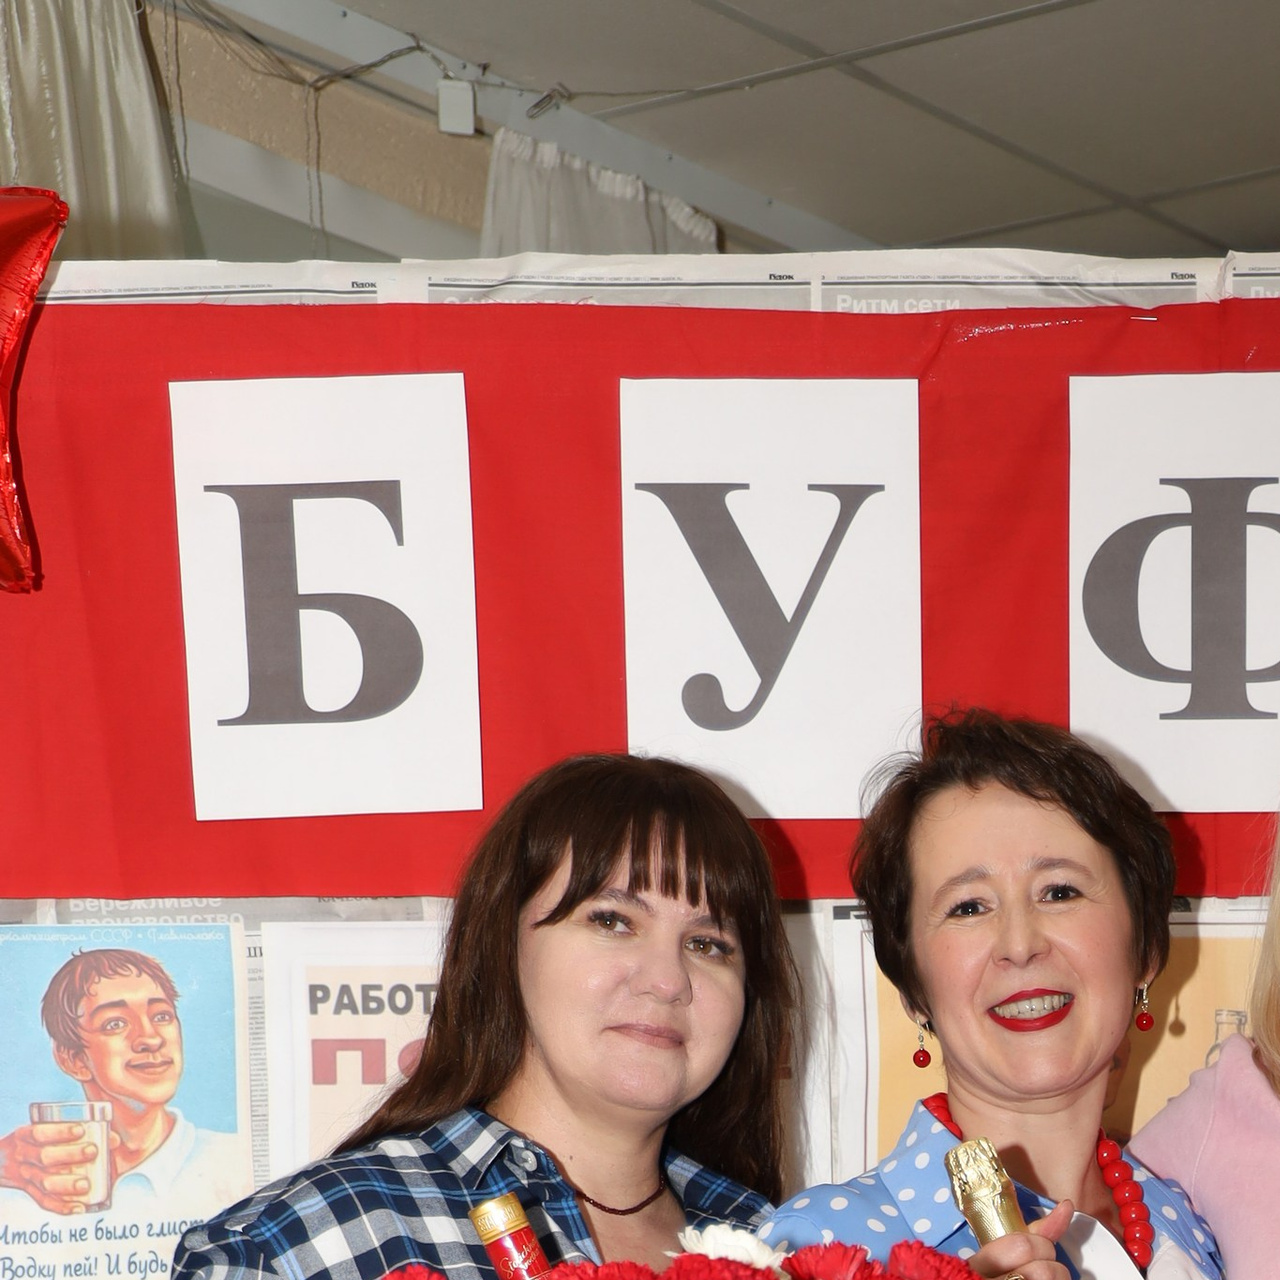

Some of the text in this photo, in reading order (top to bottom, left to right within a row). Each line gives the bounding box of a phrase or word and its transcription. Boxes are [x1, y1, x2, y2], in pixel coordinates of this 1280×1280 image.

[69, 1226, 89, 1243] не
[94, 1217, 140, 1242] было
[63, 1254, 99, 1278] пей!
[105, 1252, 121, 1275] И
[127, 1250, 168, 1280] будь
